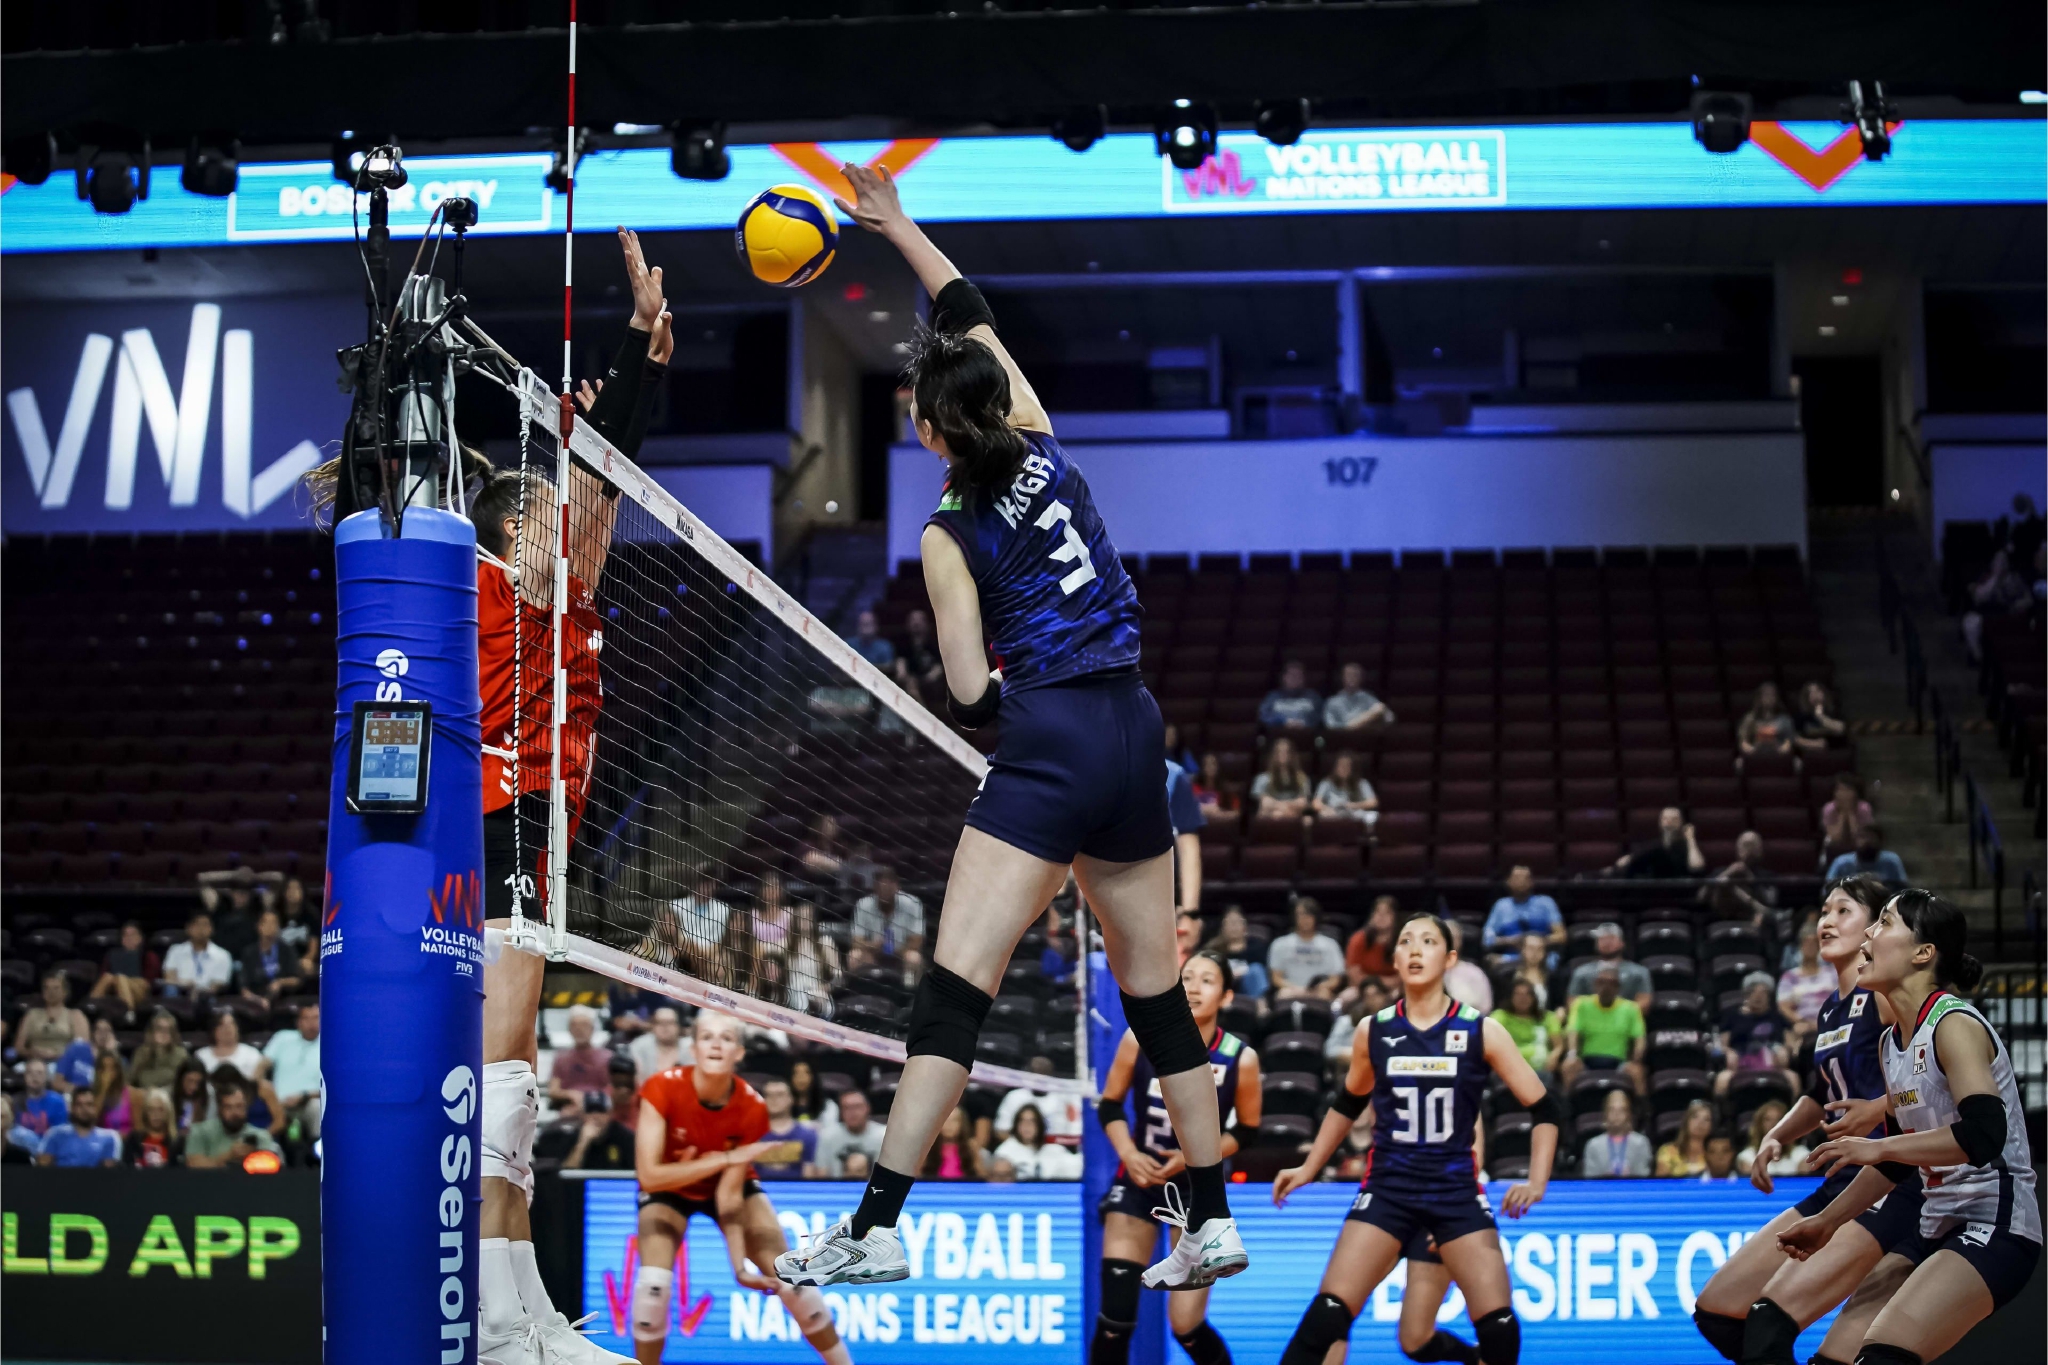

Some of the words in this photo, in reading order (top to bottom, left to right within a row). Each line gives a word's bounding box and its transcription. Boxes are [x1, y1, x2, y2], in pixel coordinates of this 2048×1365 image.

[1266, 141, 1489, 175] VOLLEYBALL
[1266, 175, 1384, 199] NATIONS
[1388, 173, 1489, 198] LEAGUE
[7, 302, 323, 520] VNL
[993, 454, 1056, 530] KOGA
[1321, 456, 1379, 487] 107
[1033, 499, 1097, 596] 3
[504, 873, 535, 898] 10
[421, 926, 484, 955] VOLLEYBA
[421, 942, 466, 959] NATIONS
[1391, 1059, 1450, 1071] CAPCOM
[1392, 1087, 1454, 1142] 30
[128, 1214, 301, 1280] APP
[439, 1134, 472, 1365] Senoh
[1373, 1231, 1660, 1322] BSIER
[730, 1291, 902, 1344] NAONS
[914, 1292, 1066, 1345] LEAGUE
